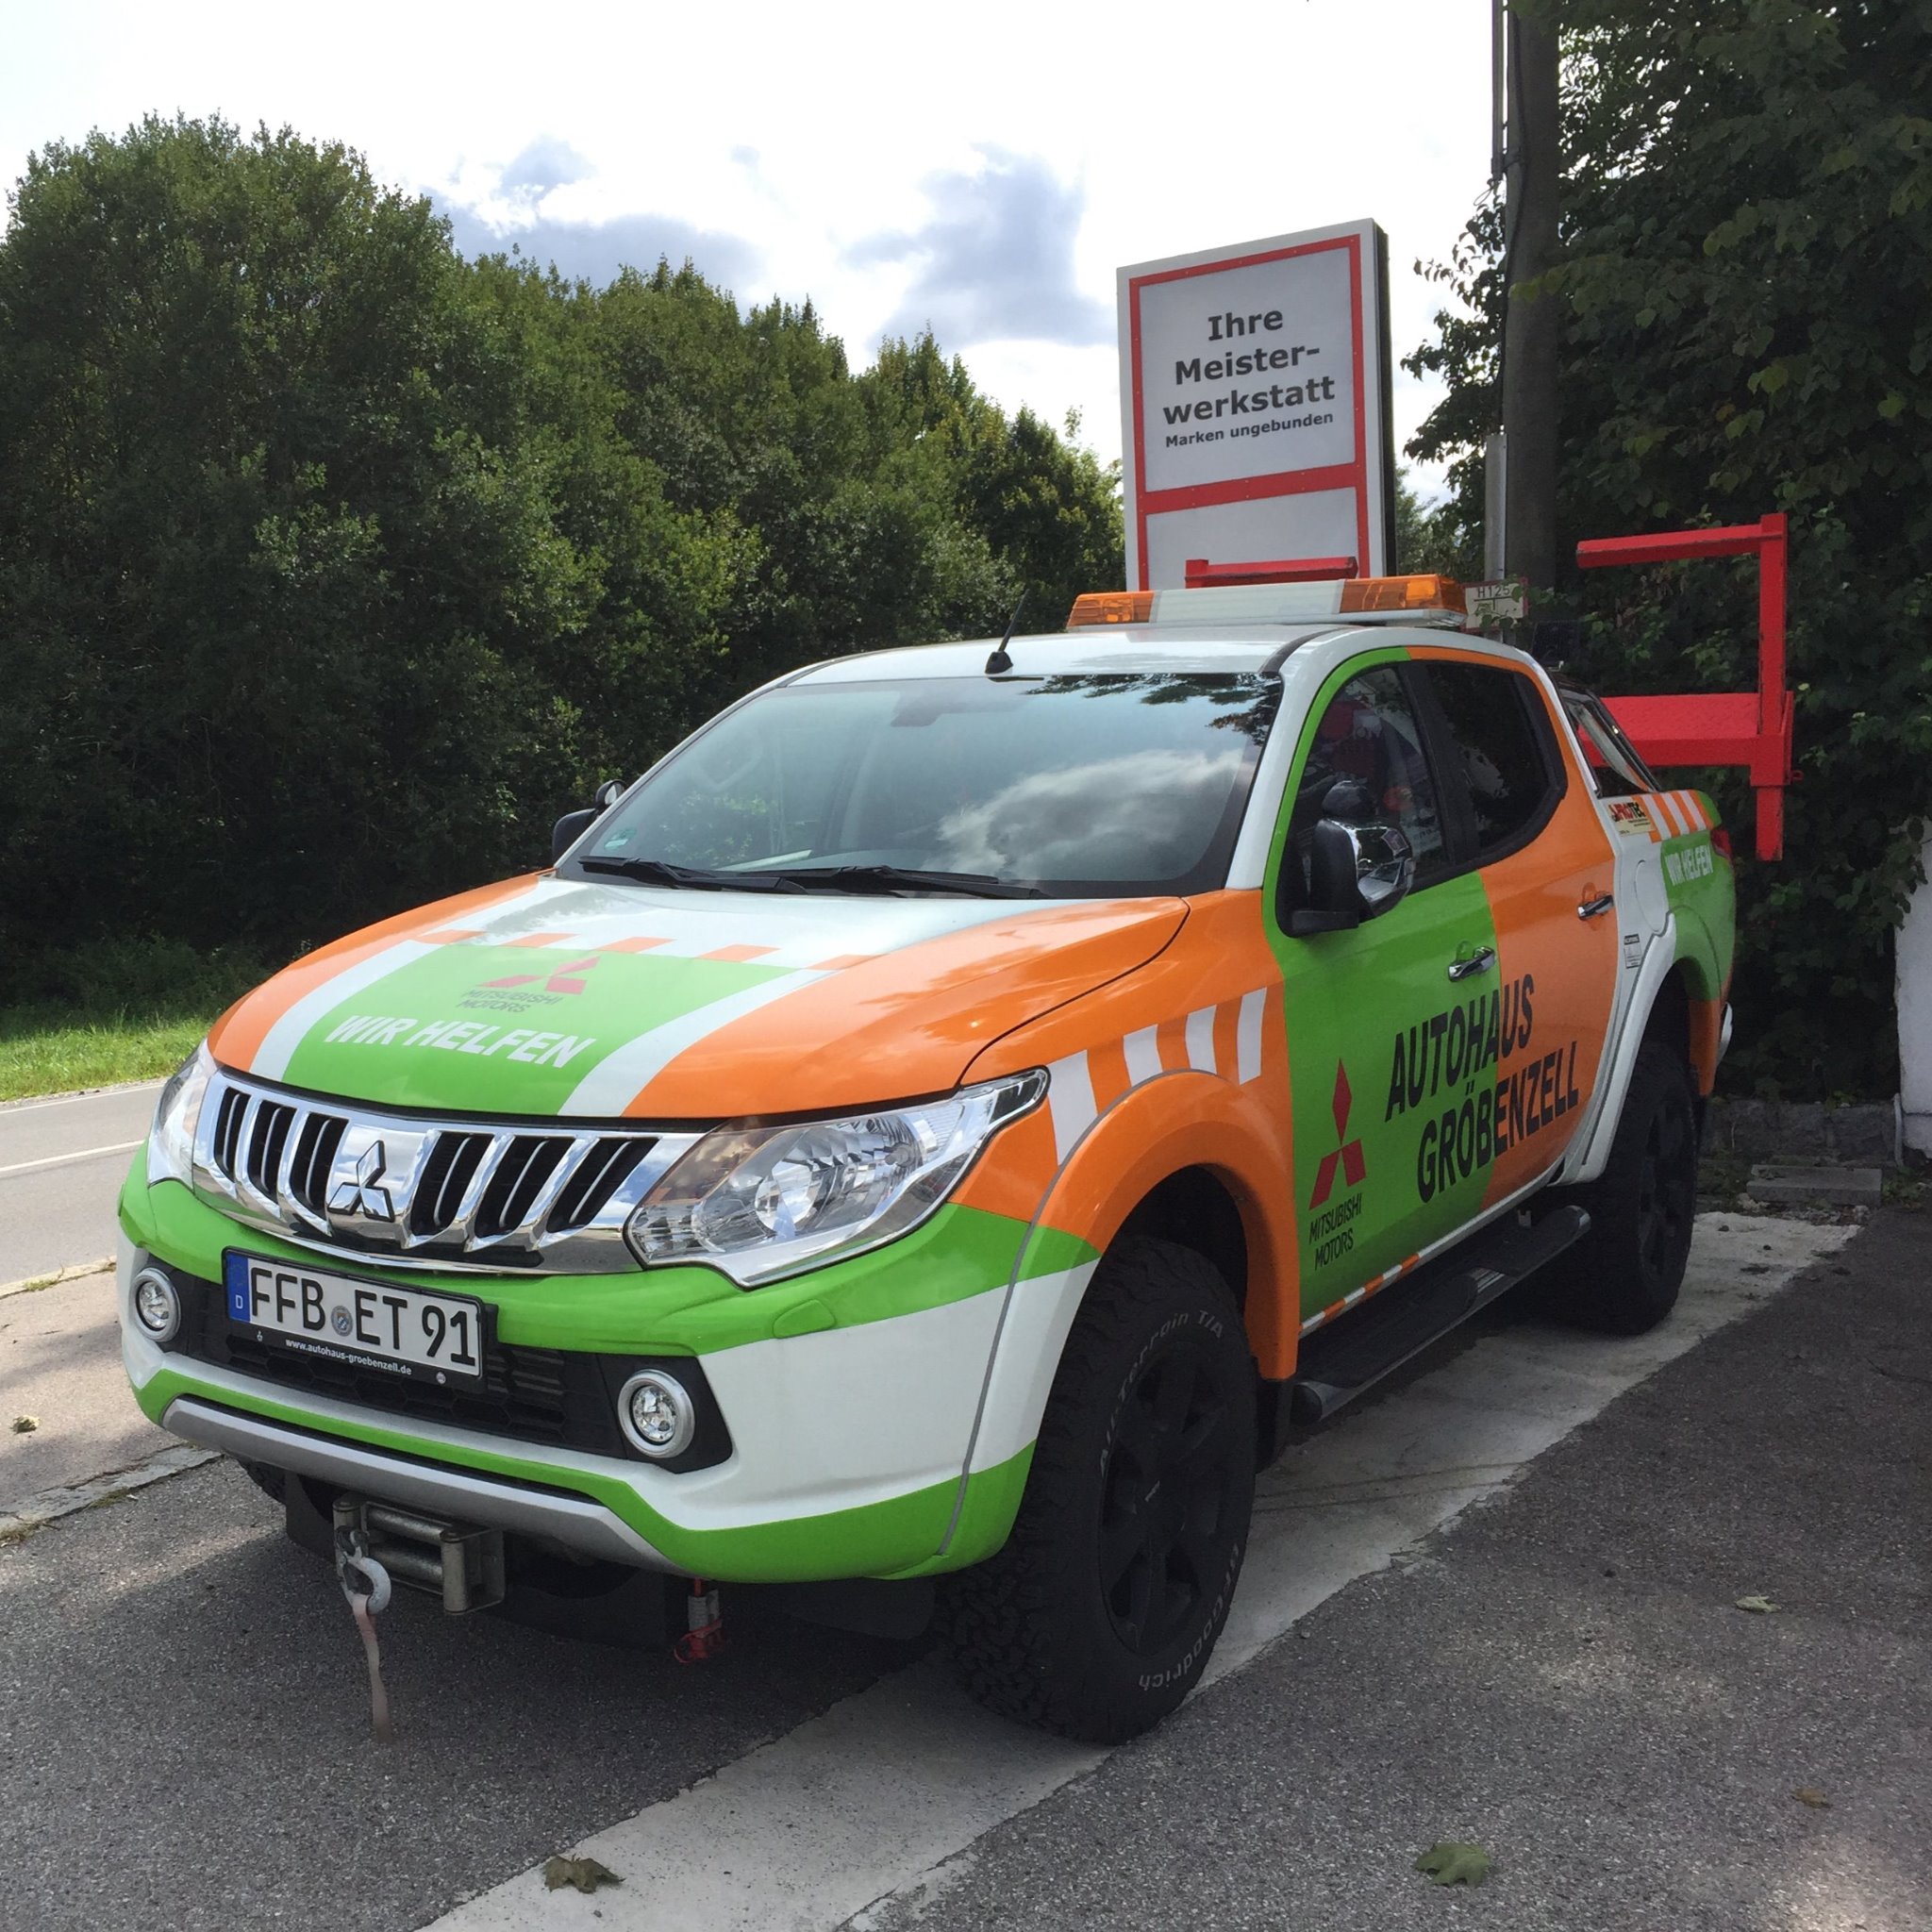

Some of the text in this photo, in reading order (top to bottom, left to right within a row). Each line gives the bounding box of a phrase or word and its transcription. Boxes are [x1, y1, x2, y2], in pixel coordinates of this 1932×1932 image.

[1208, 309, 1284, 341] Ihre
[1175, 346, 1321, 385] Meister-
[1163, 375, 1336, 425] werkstatt
[1165, 412, 1334, 448] Marken ungebunden
[1680, 844, 1713, 882] HELFEN
[455, 999, 531, 1013] MOTORS
[460, 989, 563, 1006] MITSUBISHI
[325, 1015, 596, 1069] WIR HELFEN
[1385, 974, 1535, 1123] AUTOHAUS
[1417, 1041, 1579, 1204] GRÖBENZELL
[1308, 1192, 1362, 1245] MITSUBISHI
[1315, 1229, 1354, 1272] MOTORS
[235, 1294, 243, 1310] D
[250, 1266, 475, 1367] FFB ET 91
[285, 1338, 412, 1375] www.autohaus-groebenzell.de
